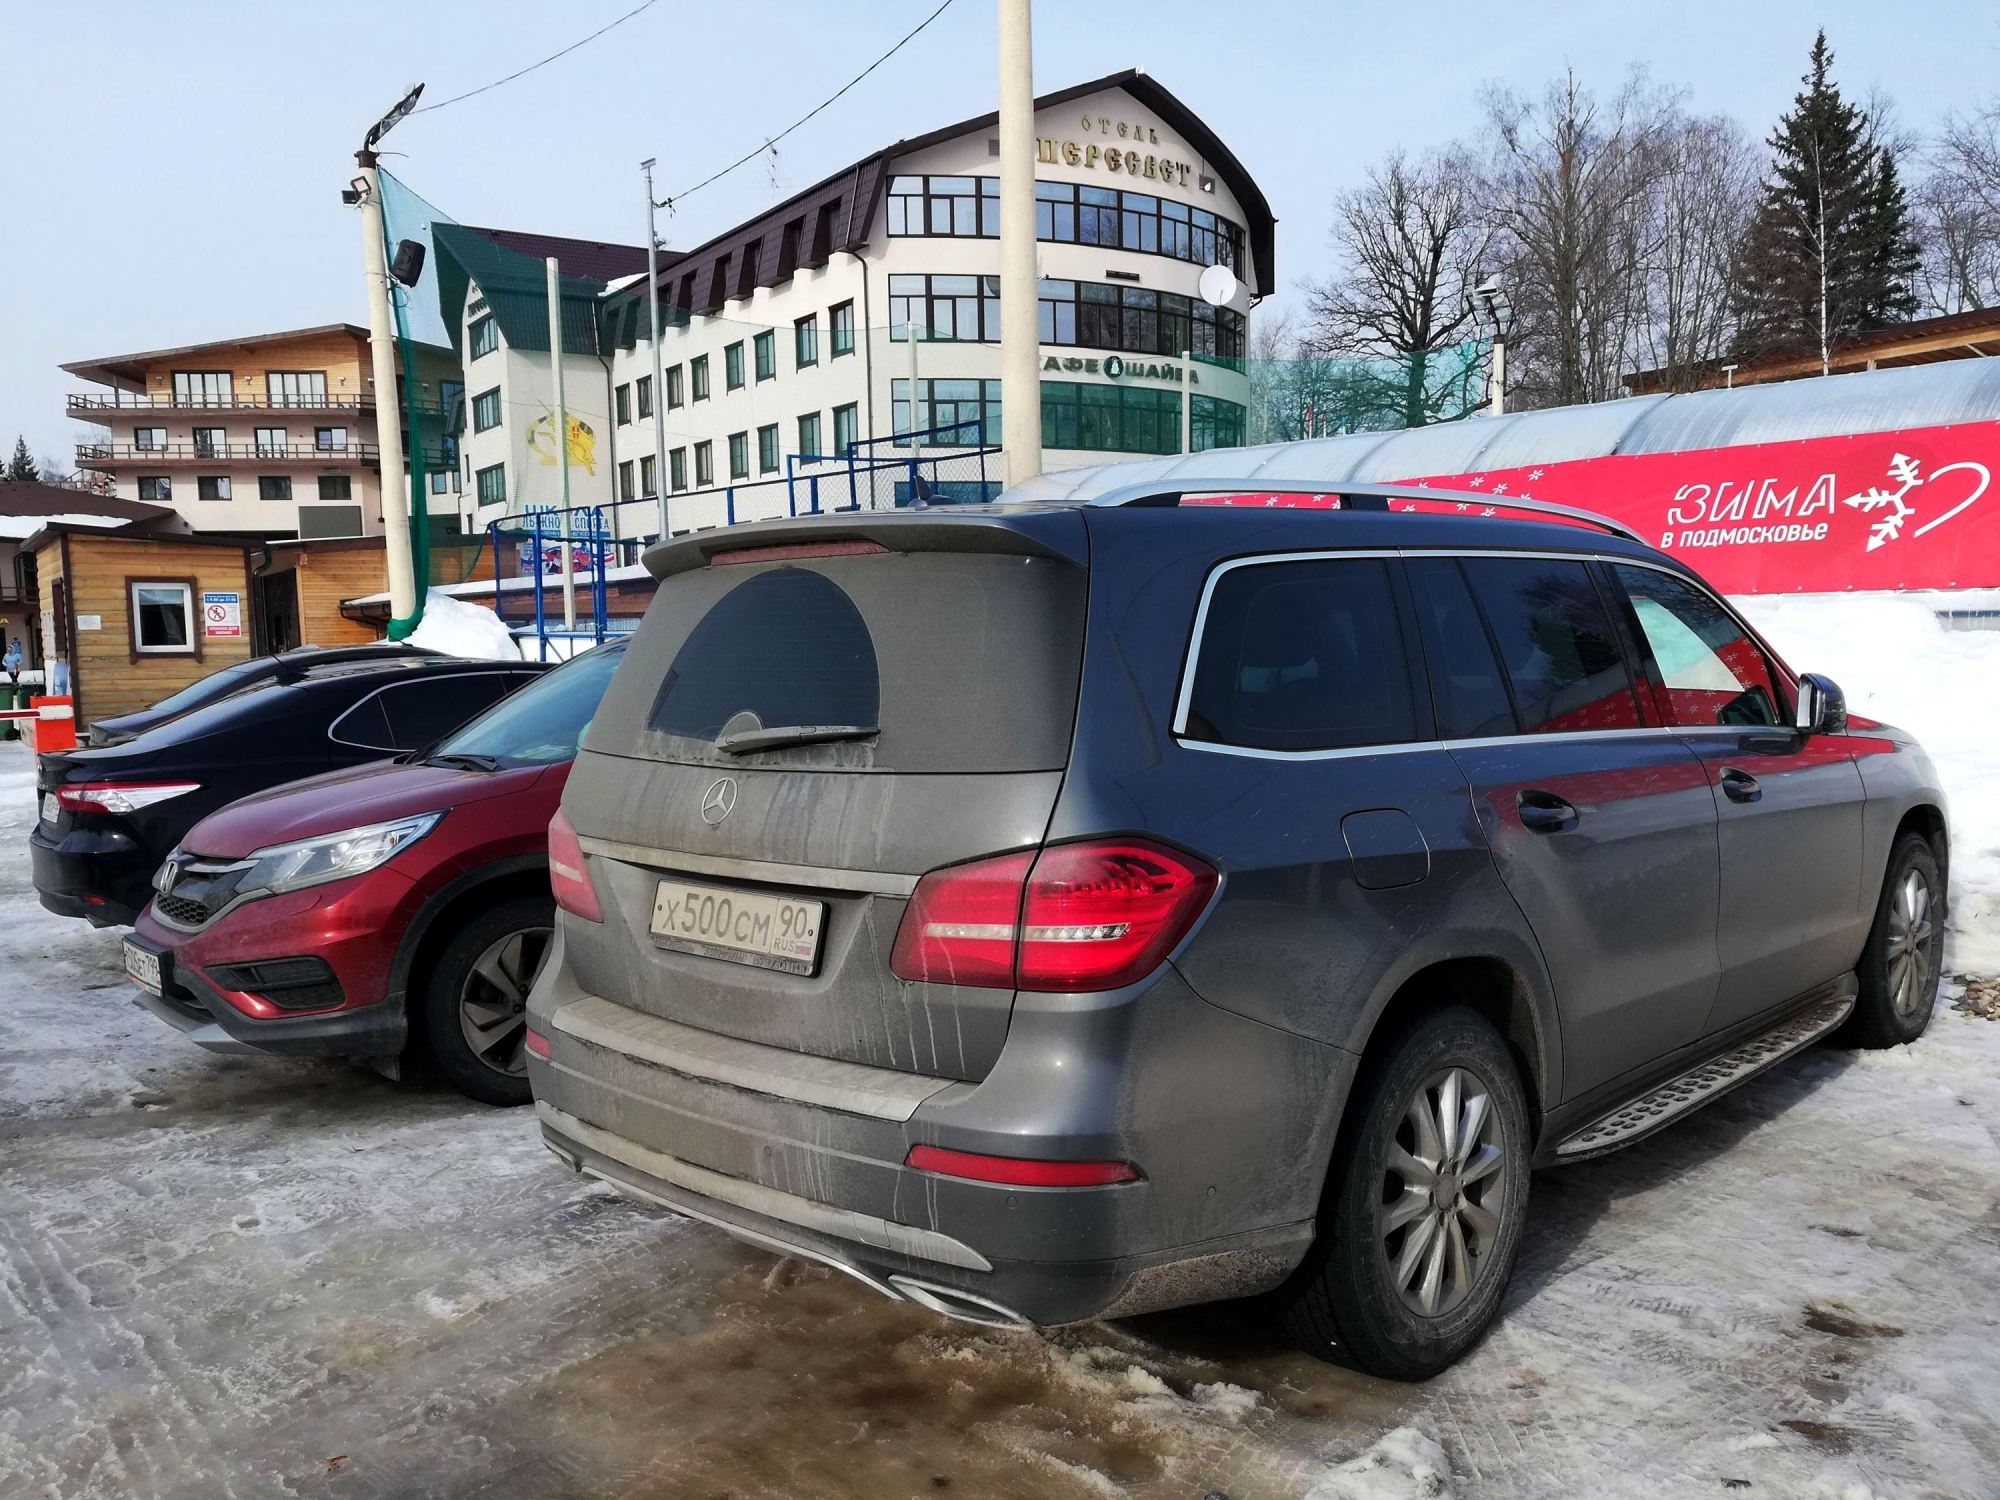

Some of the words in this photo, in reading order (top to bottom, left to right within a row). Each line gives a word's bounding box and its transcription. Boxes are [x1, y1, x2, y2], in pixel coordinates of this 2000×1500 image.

[1082, 115, 1160, 144] ОТЕЛЬ
[1036, 137, 1191, 187] ПЕРЕСВЕТ
[1040, 357, 1099, 373] АФЕ
[525, 504, 604, 518] ШКЛА
[1667, 473, 1836, 526] ЗИМА
[780, 905, 808, 939] 90
[774, 938, 796, 951] RUS
